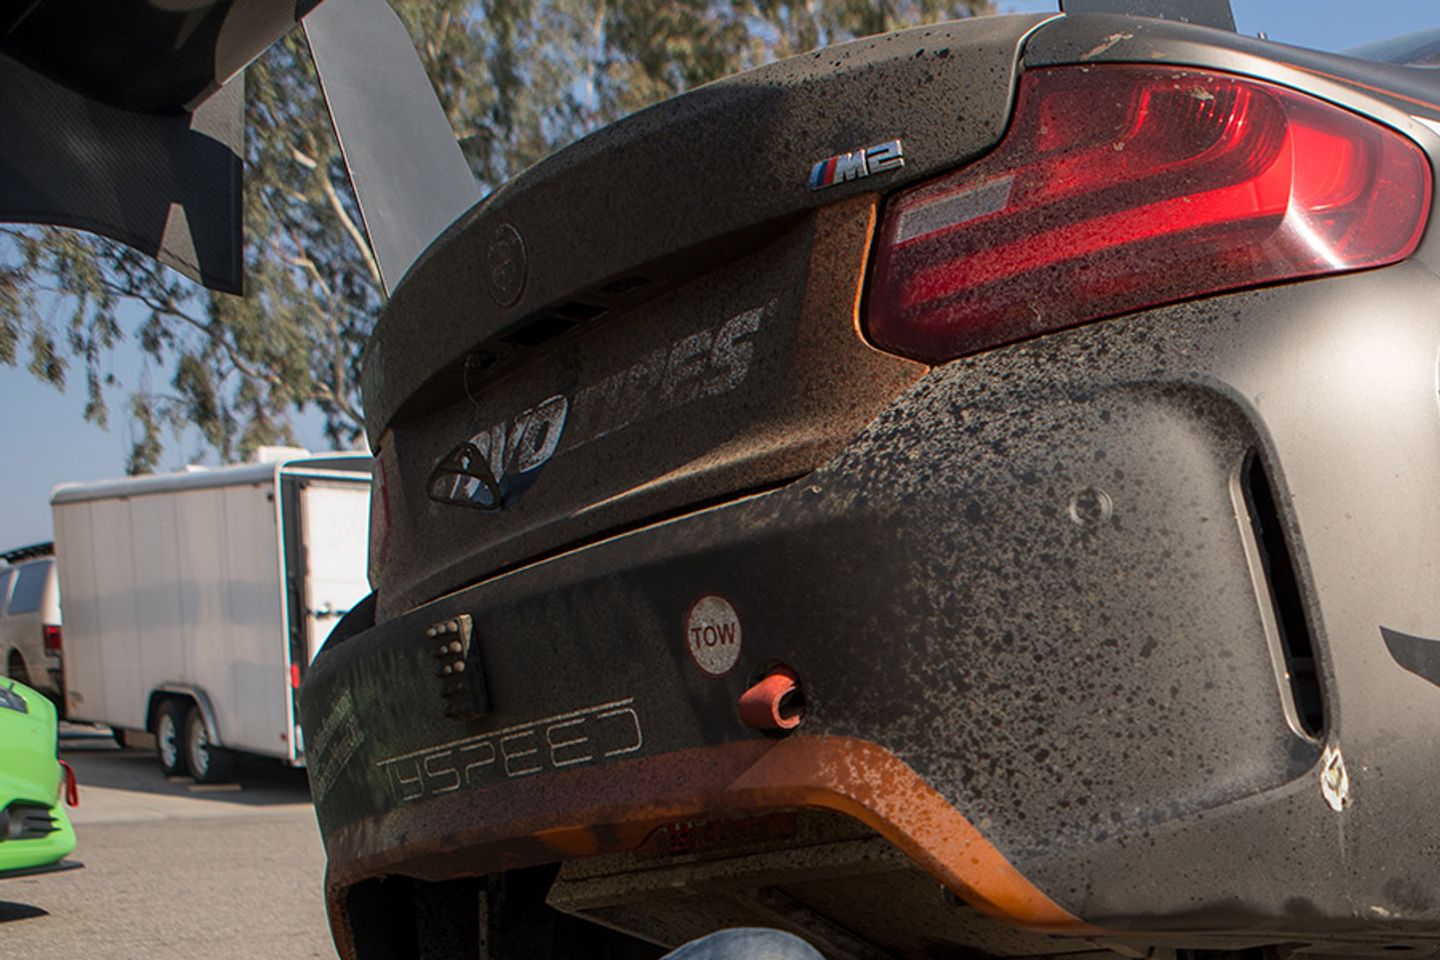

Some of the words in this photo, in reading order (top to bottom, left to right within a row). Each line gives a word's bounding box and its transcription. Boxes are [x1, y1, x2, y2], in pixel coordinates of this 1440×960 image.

[833, 139, 905, 185] M2
[691, 622, 736, 649] TOW
[376, 697, 643, 801] TYSPEED
